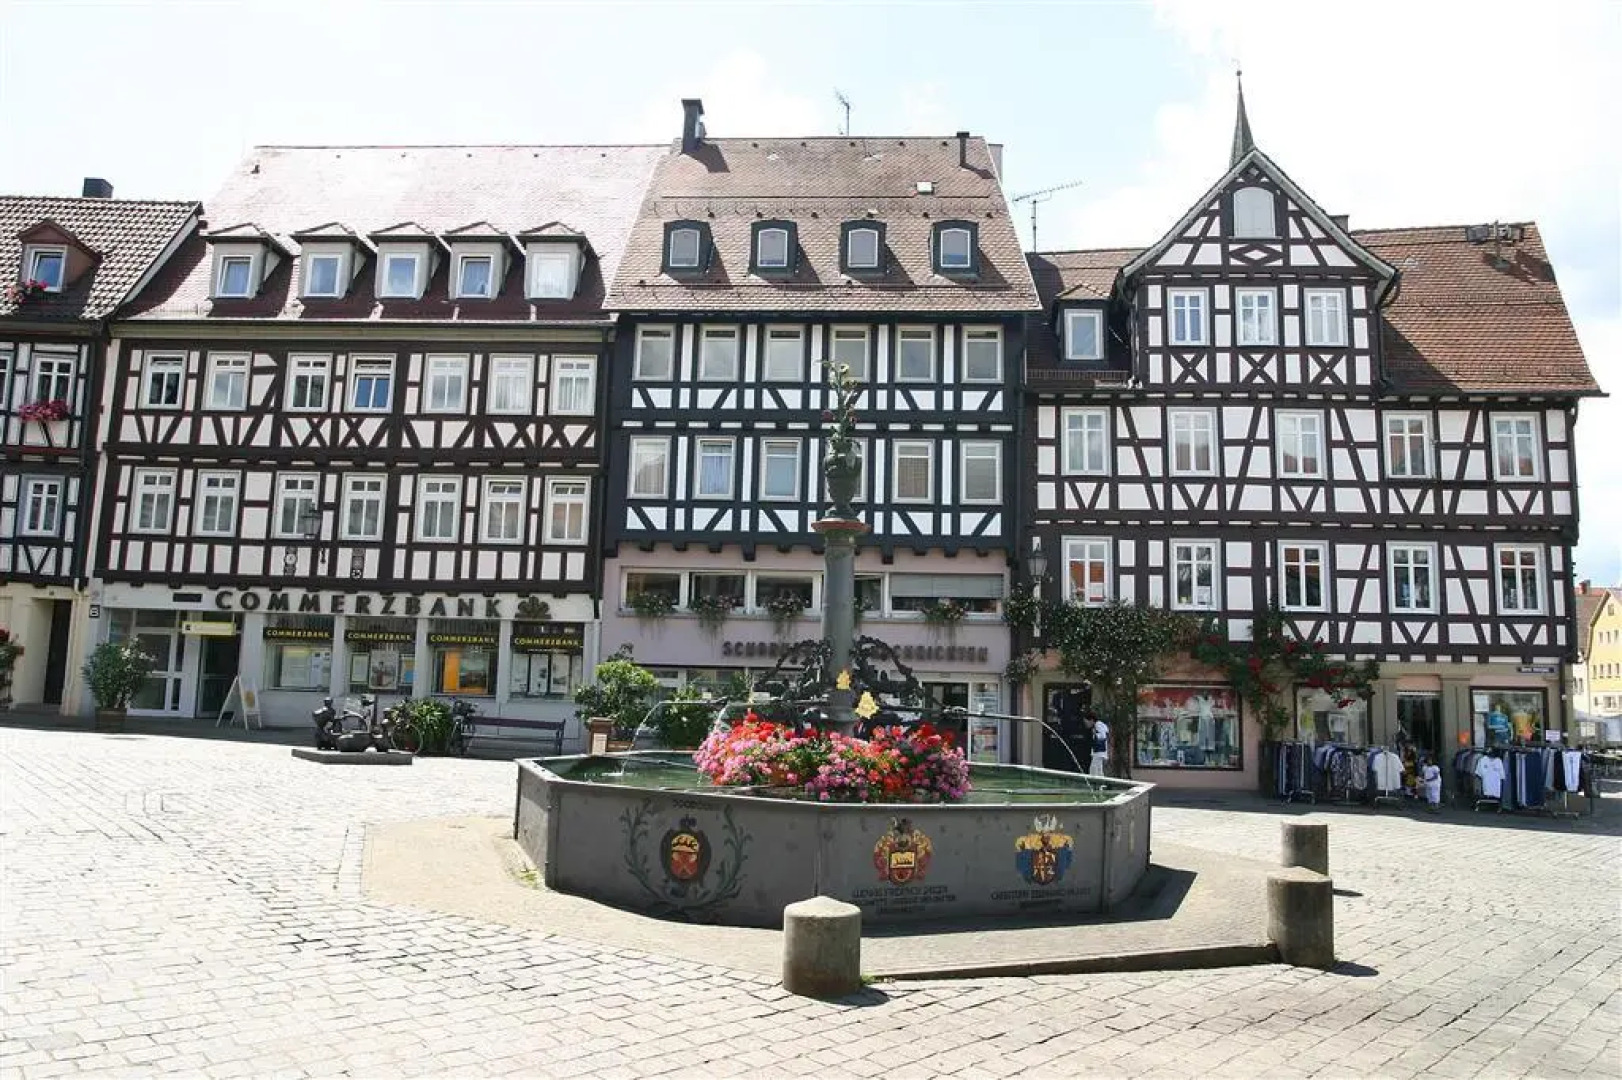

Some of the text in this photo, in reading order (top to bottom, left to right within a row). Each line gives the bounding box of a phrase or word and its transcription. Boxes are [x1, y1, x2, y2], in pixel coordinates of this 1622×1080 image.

[215, 590, 501, 617] COMMERZBANK
[266, 629, 330, 638] COMMERZBANK
[347, 632, 412, 641] COMMERZBANK
[430, 634, 495, 643] COMMERZBANK
[514, 637, 579, 646] COMMERZBANK
